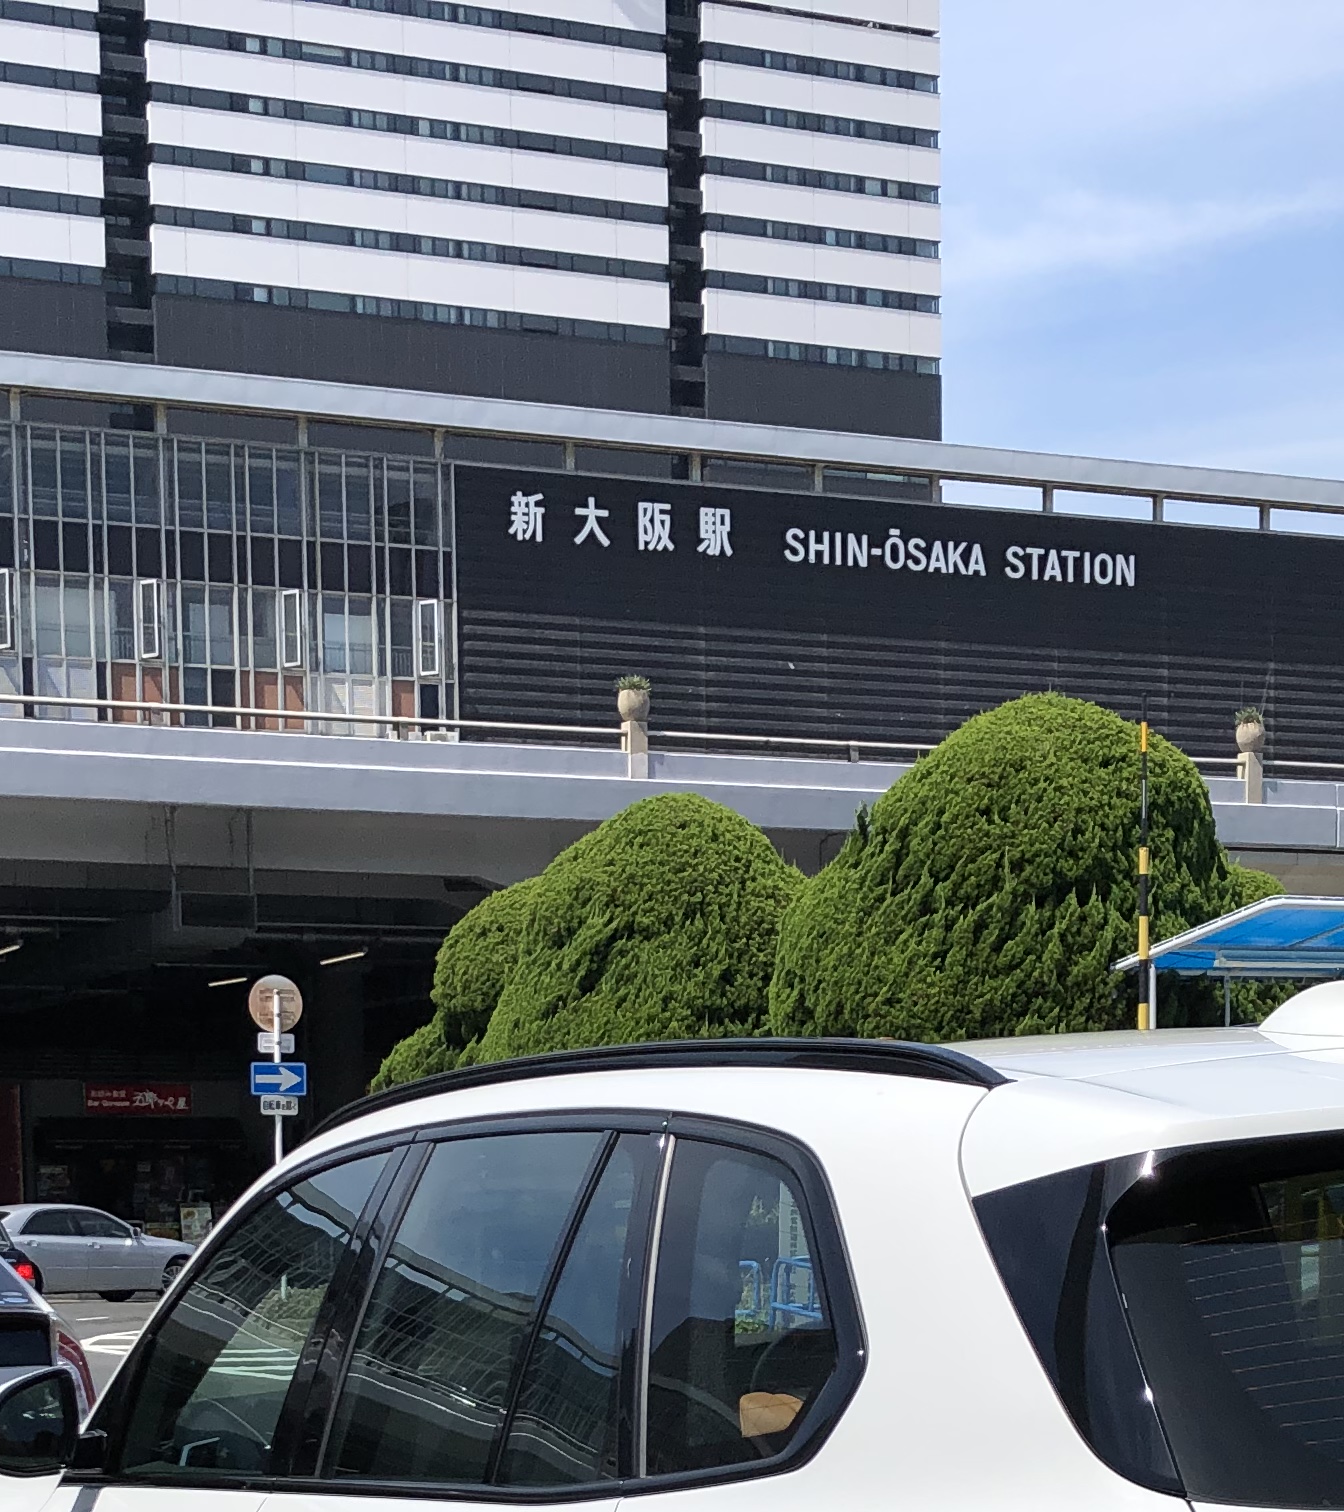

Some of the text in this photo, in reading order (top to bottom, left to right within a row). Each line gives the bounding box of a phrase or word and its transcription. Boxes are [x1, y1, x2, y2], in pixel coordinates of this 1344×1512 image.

[508, 491, 733, 557] 新大阪駅
[784, 528, 1136, 587] SHIN-ŌSAKA STATION
